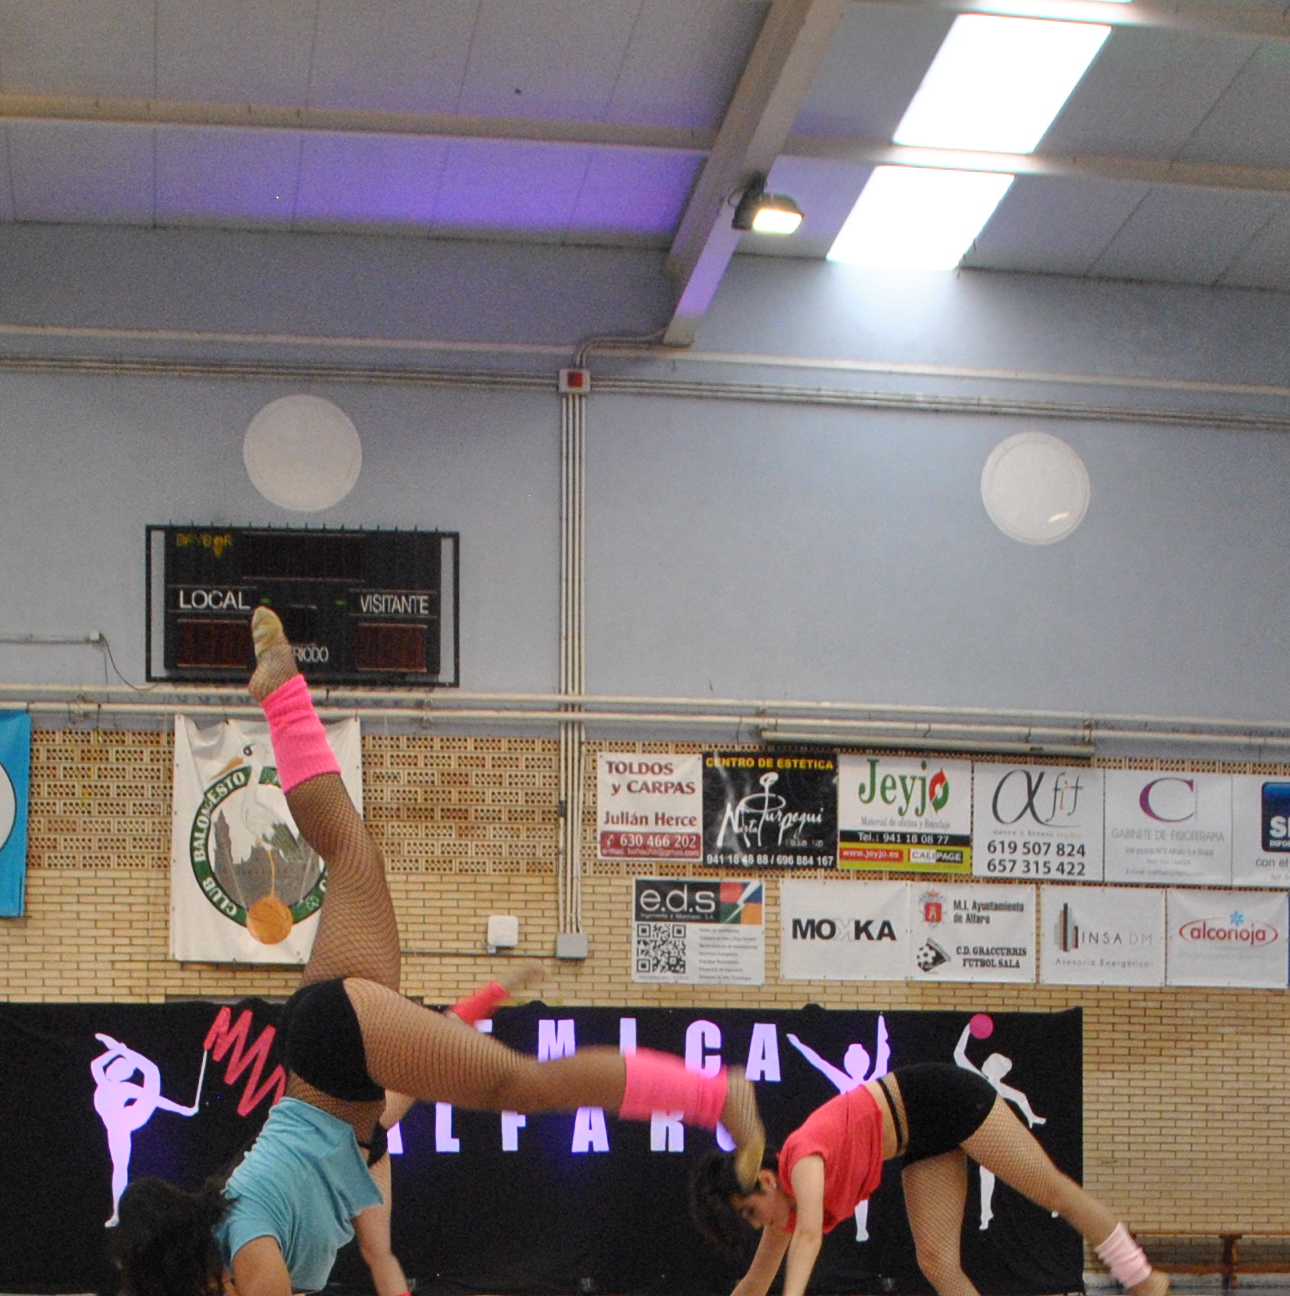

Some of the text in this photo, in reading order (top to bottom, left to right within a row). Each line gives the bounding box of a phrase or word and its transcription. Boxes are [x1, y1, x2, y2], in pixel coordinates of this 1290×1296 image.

[179, 589, 251, 609] LOCAL
[360, 593, 429, 614] VISITANTE
[292, 646, 329, 662] RIODO
[605, 760, 674, 776] TOLDOS
[705, 757, 755, 768] CENTRO
[758, 758, 774, 768] DE
[611, 780, 696, 796] y CARPAS
[1139, 776, 1194, 823] C
[604, 811, 697, 827] Julián Herce
[620, 833, 697, 849] 630 466 202
[883, 833, 901, 843] 941
[906, 834, 918, 844] 18
[937, 835, 949, 845] 77
[987, 840, 1086, 858] 619 507 824
[706, 854, 725, 864] 941
[729, 854, 740, 864] 18
[987, 858, 1086, 876] 657 315 422
[1255, 858, 1275, 868] con
[1279, 857, 1289, 868] el
[202, 876, 238, 916] CLUB
[640, 884, 716, 913] e.d.s
[998, 959, 1020, 969] SALA
[387, 1102, 737, 1155] LFAR
